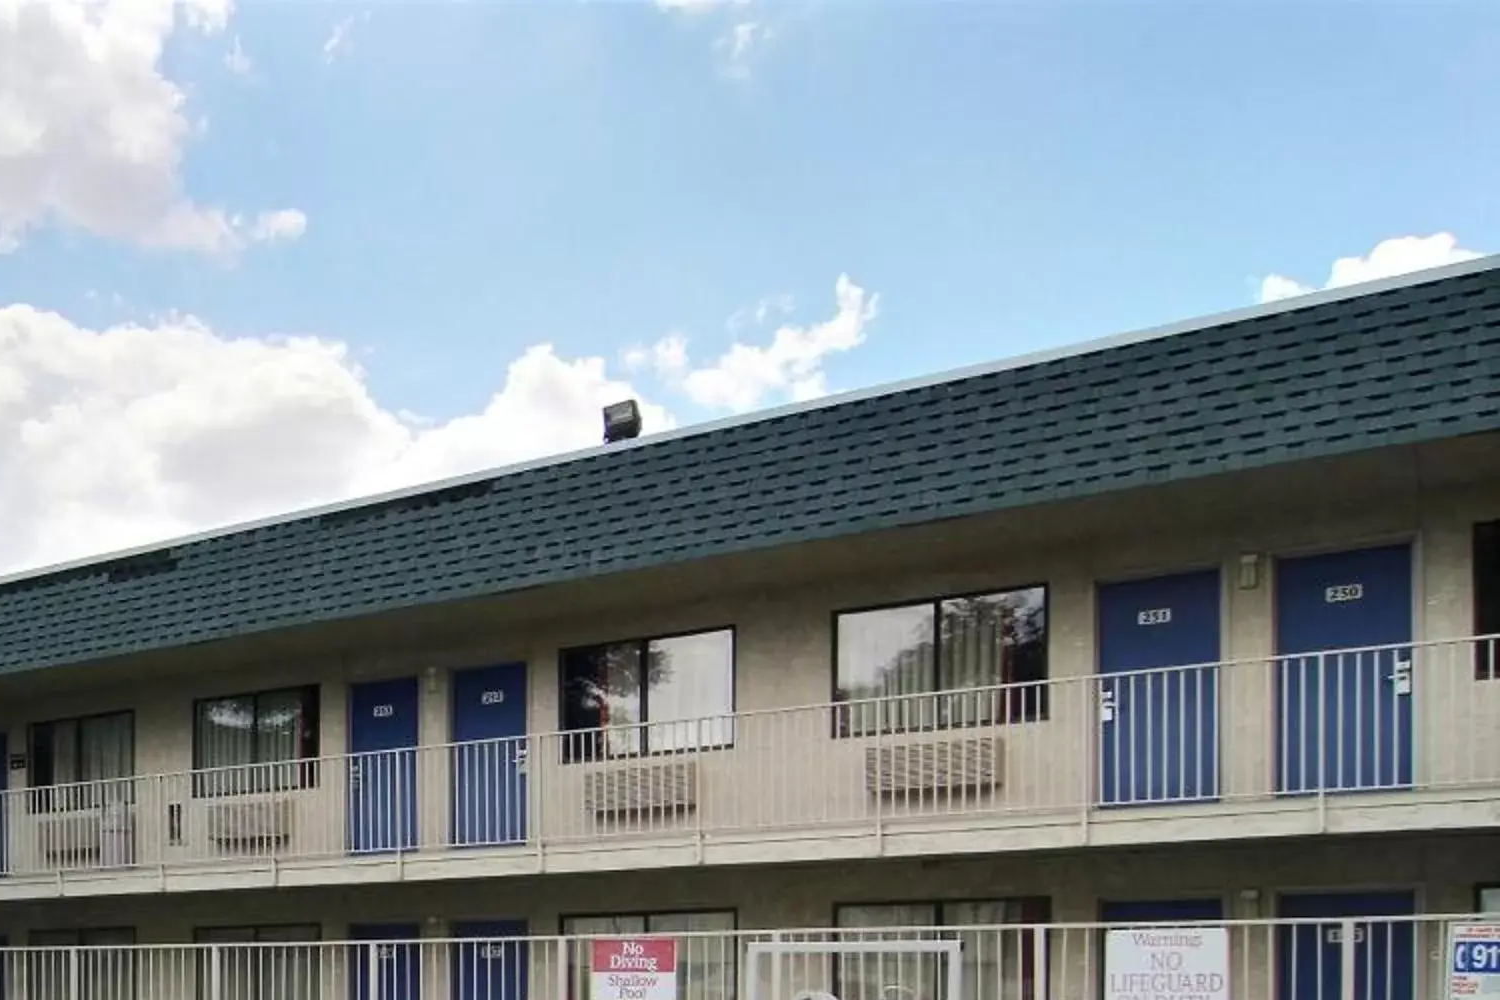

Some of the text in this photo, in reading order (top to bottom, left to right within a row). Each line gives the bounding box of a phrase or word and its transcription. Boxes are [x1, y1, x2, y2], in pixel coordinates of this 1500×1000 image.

[622, 941, 645, 954] No
[610, 955, 657, 972] Diving
[1150, 952, 1183, 971] NO
[608, 975, 659, 988] Shallow
[1111, 973, 1224, 993] LIFEGUARD
[619, 987, 647, 999] Pool
